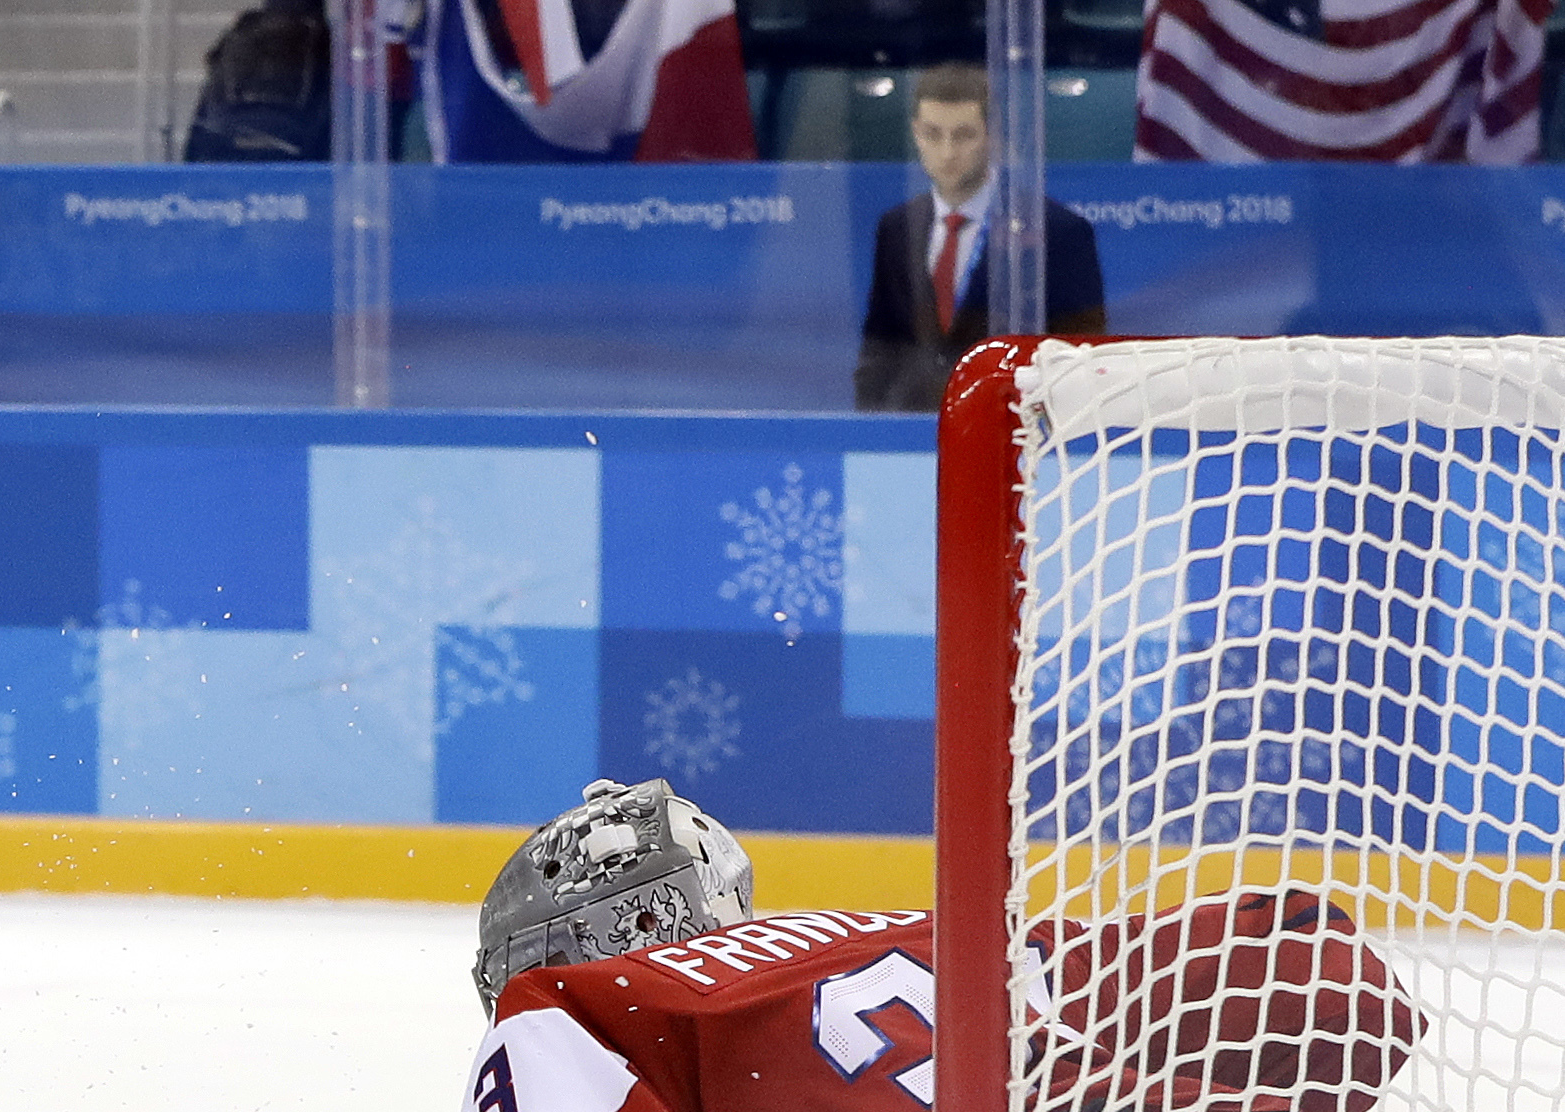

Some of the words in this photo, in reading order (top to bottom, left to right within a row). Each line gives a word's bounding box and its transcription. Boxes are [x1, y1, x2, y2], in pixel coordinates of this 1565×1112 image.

[64, 193, 244, 226] PyeongChang
[246, 193, 307, 221] 2018
[540, 197, 727, 230] PyeongChang
[730, 196, 793, 223] 2018
[1228, 195, 1291, 223] 2018
